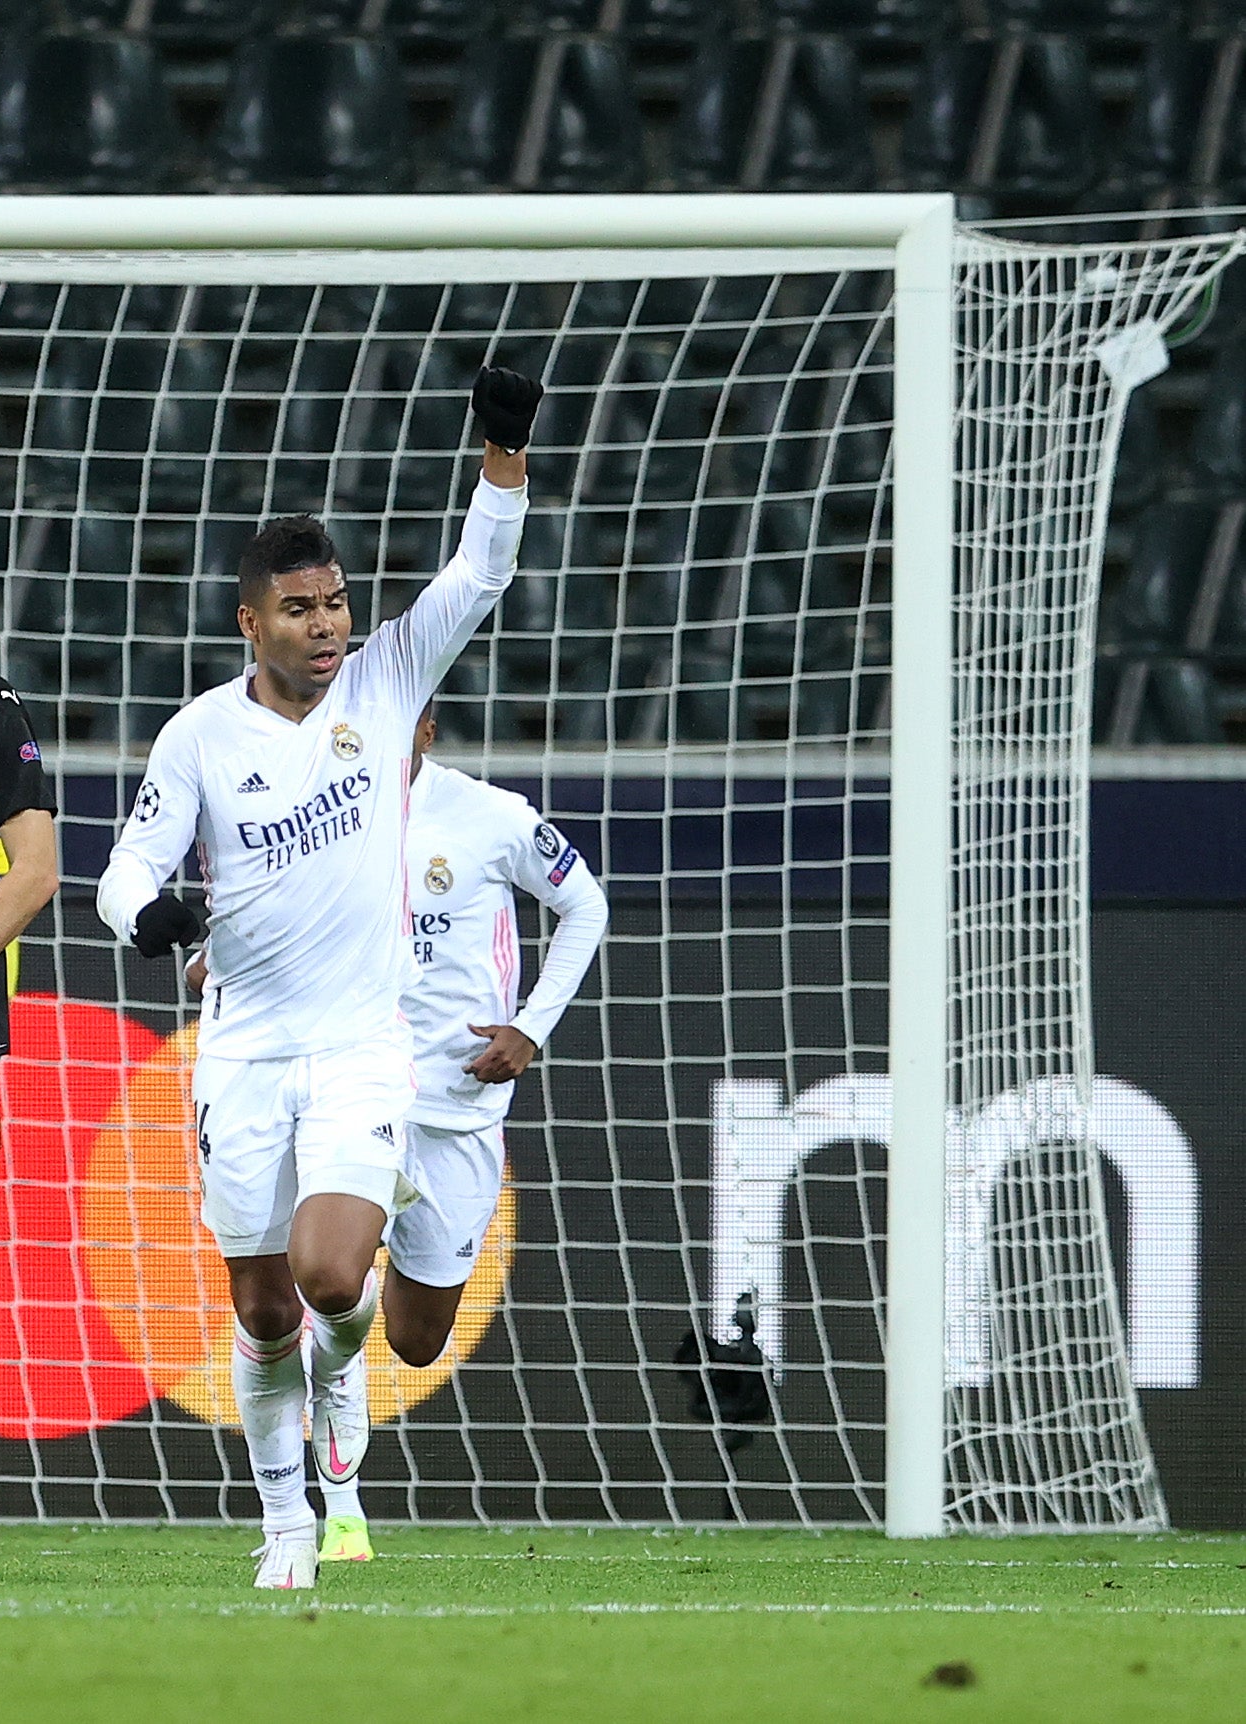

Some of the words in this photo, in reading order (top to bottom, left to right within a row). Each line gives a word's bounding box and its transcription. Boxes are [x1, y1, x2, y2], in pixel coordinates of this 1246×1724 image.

[236, 767, 371, 850] Emirates
[237, 784, 271, 794] adidas
[266, 843, 295, 873] FLY
[300, 806, 362, 856] BETTER
